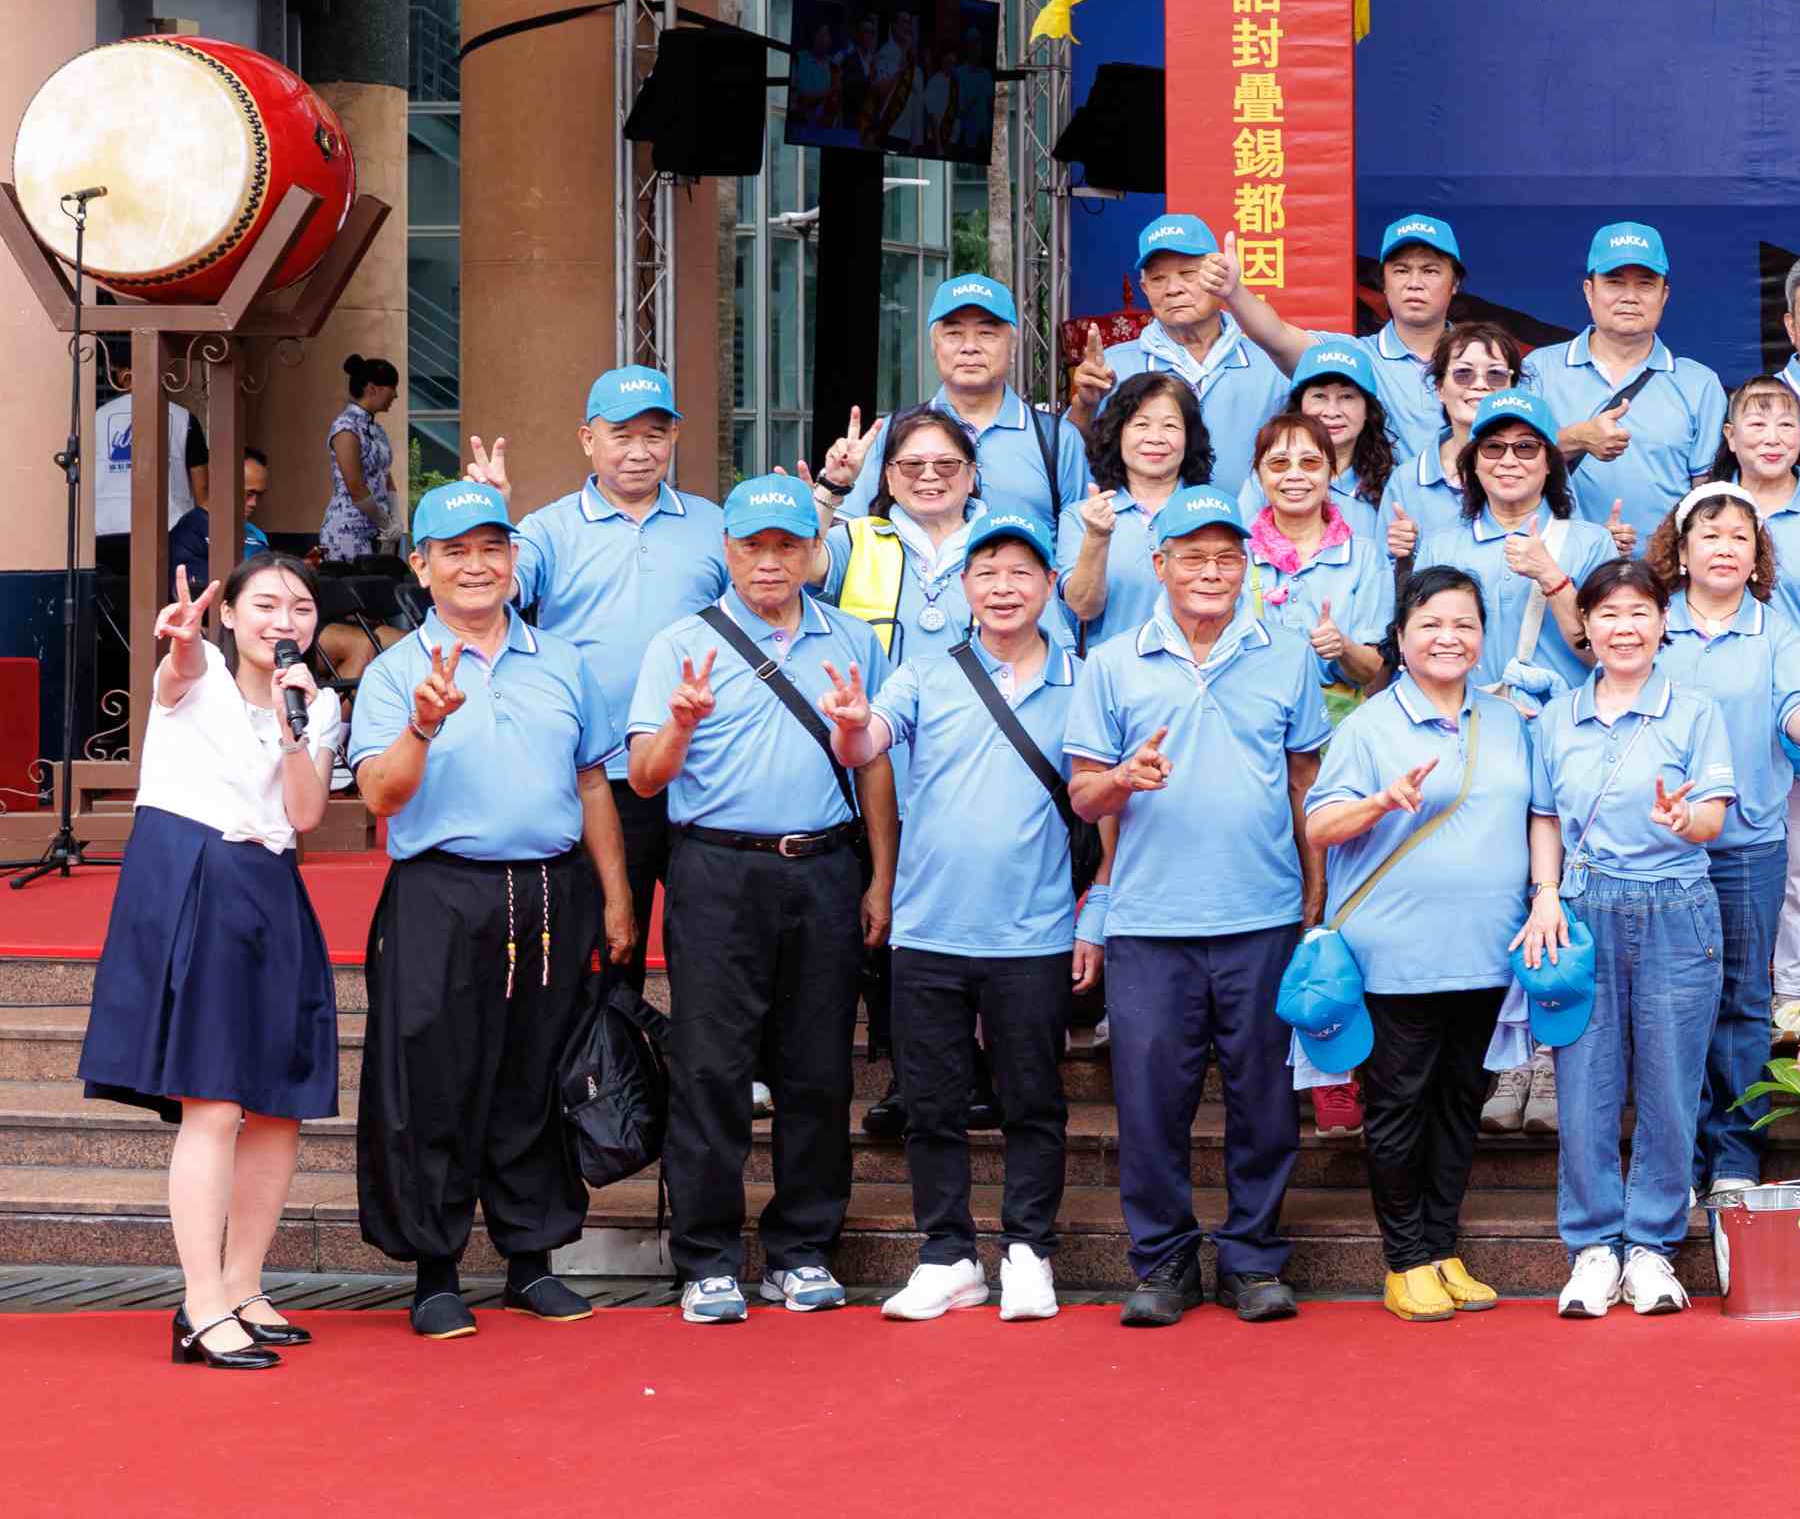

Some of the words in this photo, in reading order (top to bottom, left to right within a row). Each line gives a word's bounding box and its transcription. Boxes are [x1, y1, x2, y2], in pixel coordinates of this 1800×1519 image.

[1397, 222, 1436, 236] HAKKA
[1610, 233, 1649, 248] HAKKA
[952, 283, 993, 298] HAKKA
[1316, 351, 1357, 368] HAKKA
[619, 378, 661, 394] HAKKA
[1491, 396, 1533, 412] HAKKA
[445, 492, 492, 511] HAKKA
[748, 488, 797, 508] HAKKA
[1185, 496, 1232, 514] HAKKA
